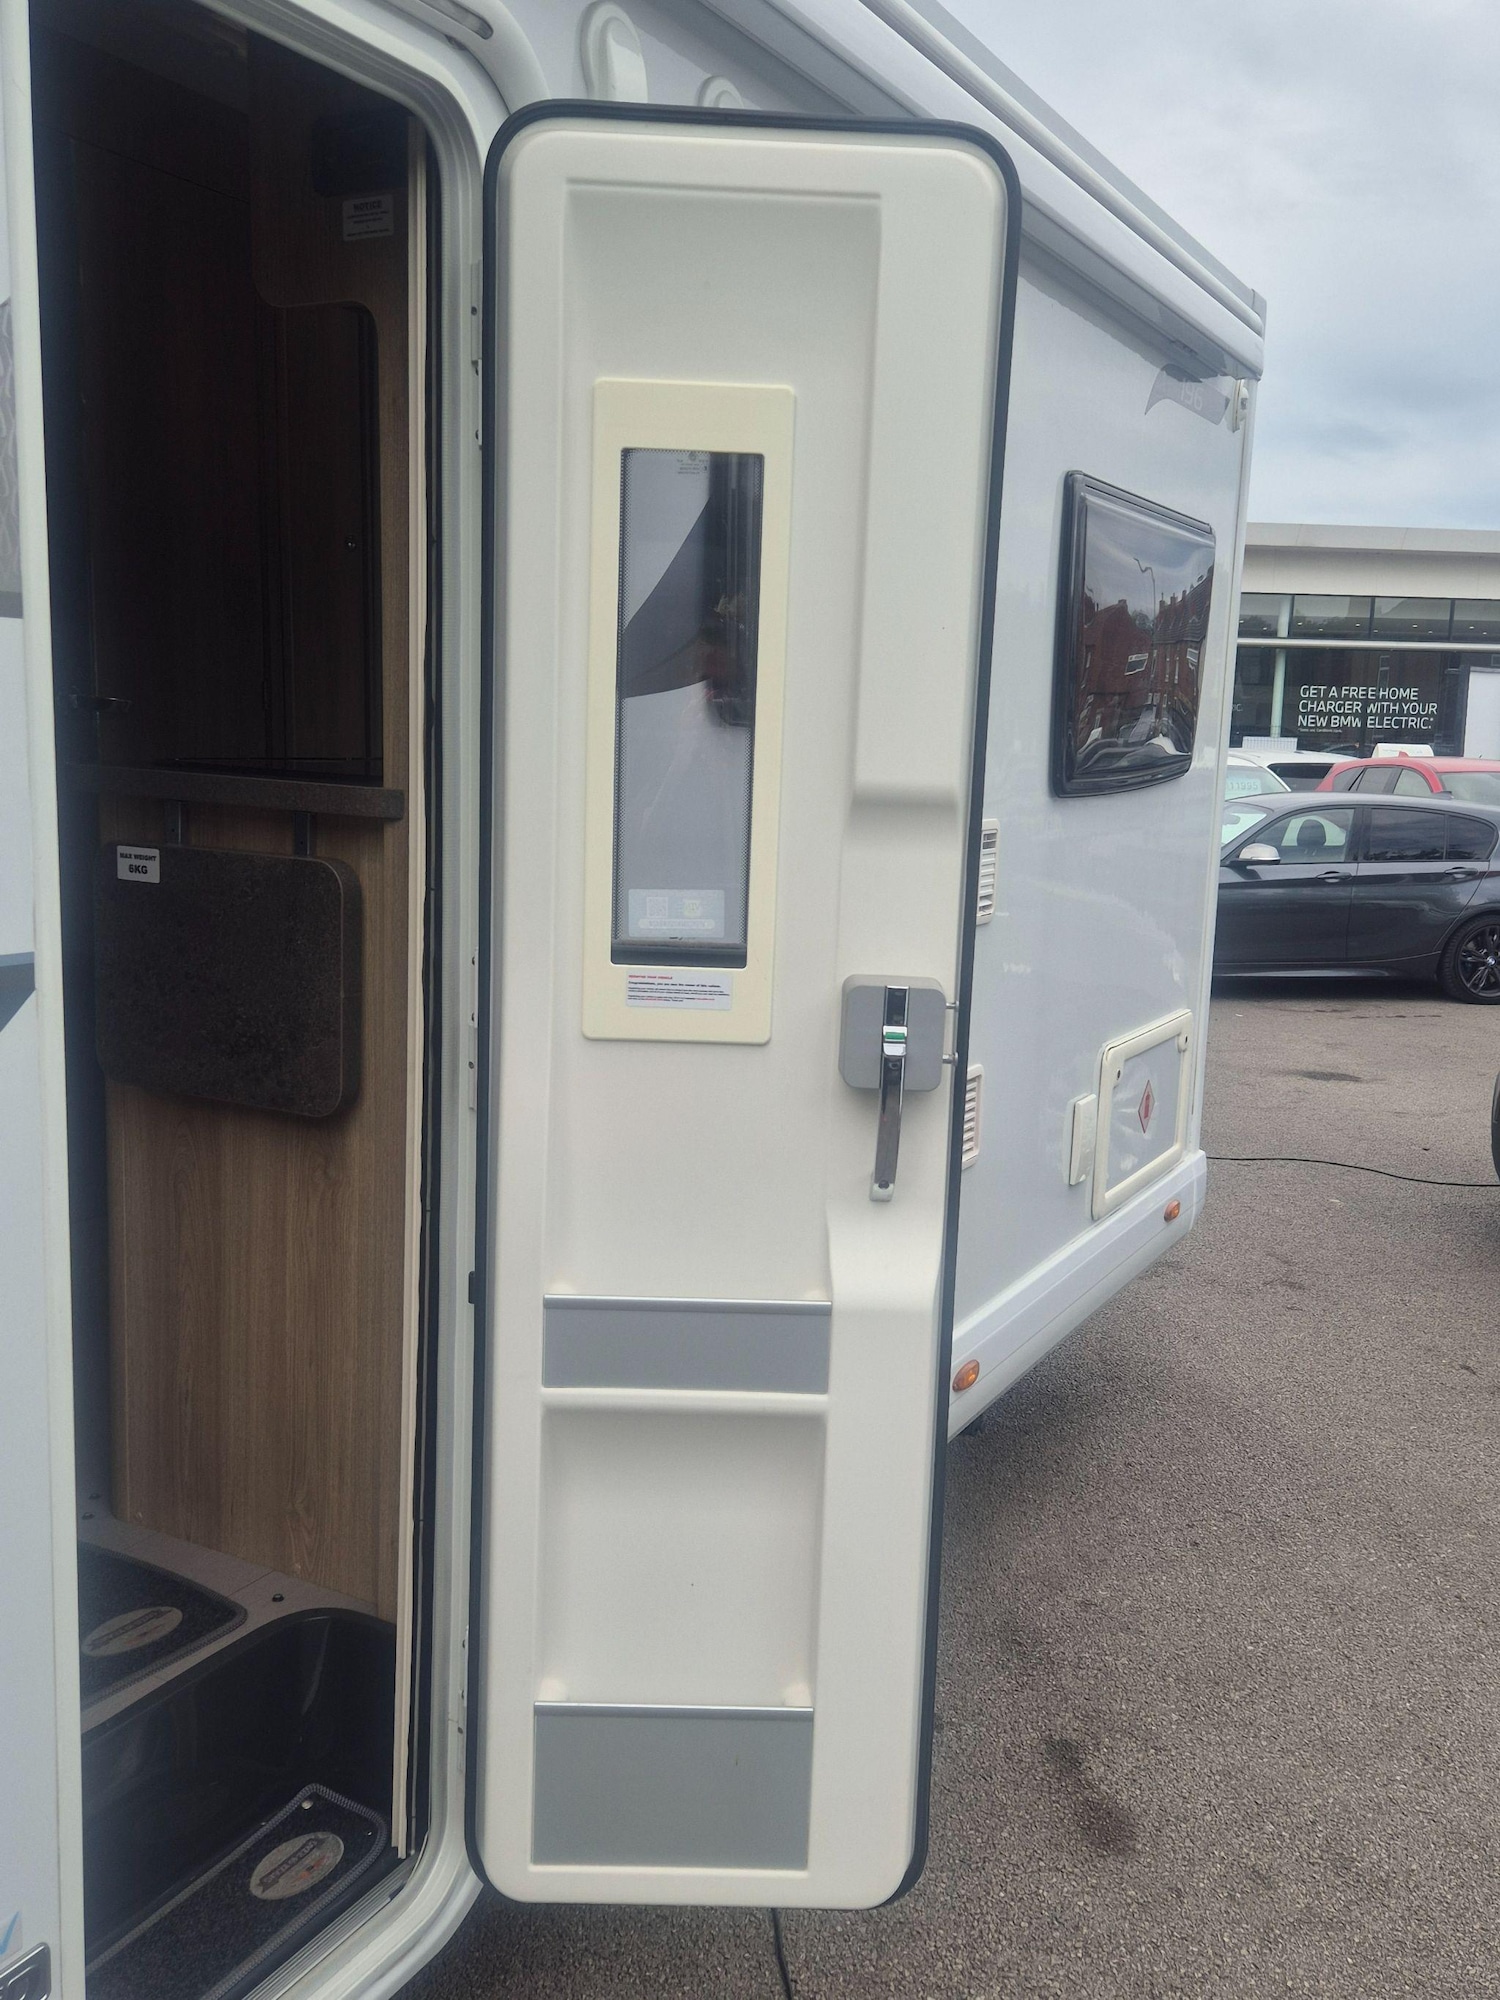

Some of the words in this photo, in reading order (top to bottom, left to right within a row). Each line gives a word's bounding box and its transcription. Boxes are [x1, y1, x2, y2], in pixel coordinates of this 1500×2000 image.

[353, 200, 381, 210] NOTICE
[1300, 685, 1327, 698] GET
[1328, 686, 1338, 698] A
[1341, 686, 1376, 699] FREE
[1379, 687, 1419, 700] HOME
[1299, 700, 1362, 714] CHARGER
[1367, 702, 1399, 714] WITH
[1402, 702, 1438, 715] YOUR
[1297, 714, 1328, 727] NEW
[1330, 715, 1362, 728] BMW
[133, 854, 157, 862] WEIGHT
[129, 864, 148, 874] 6KG
